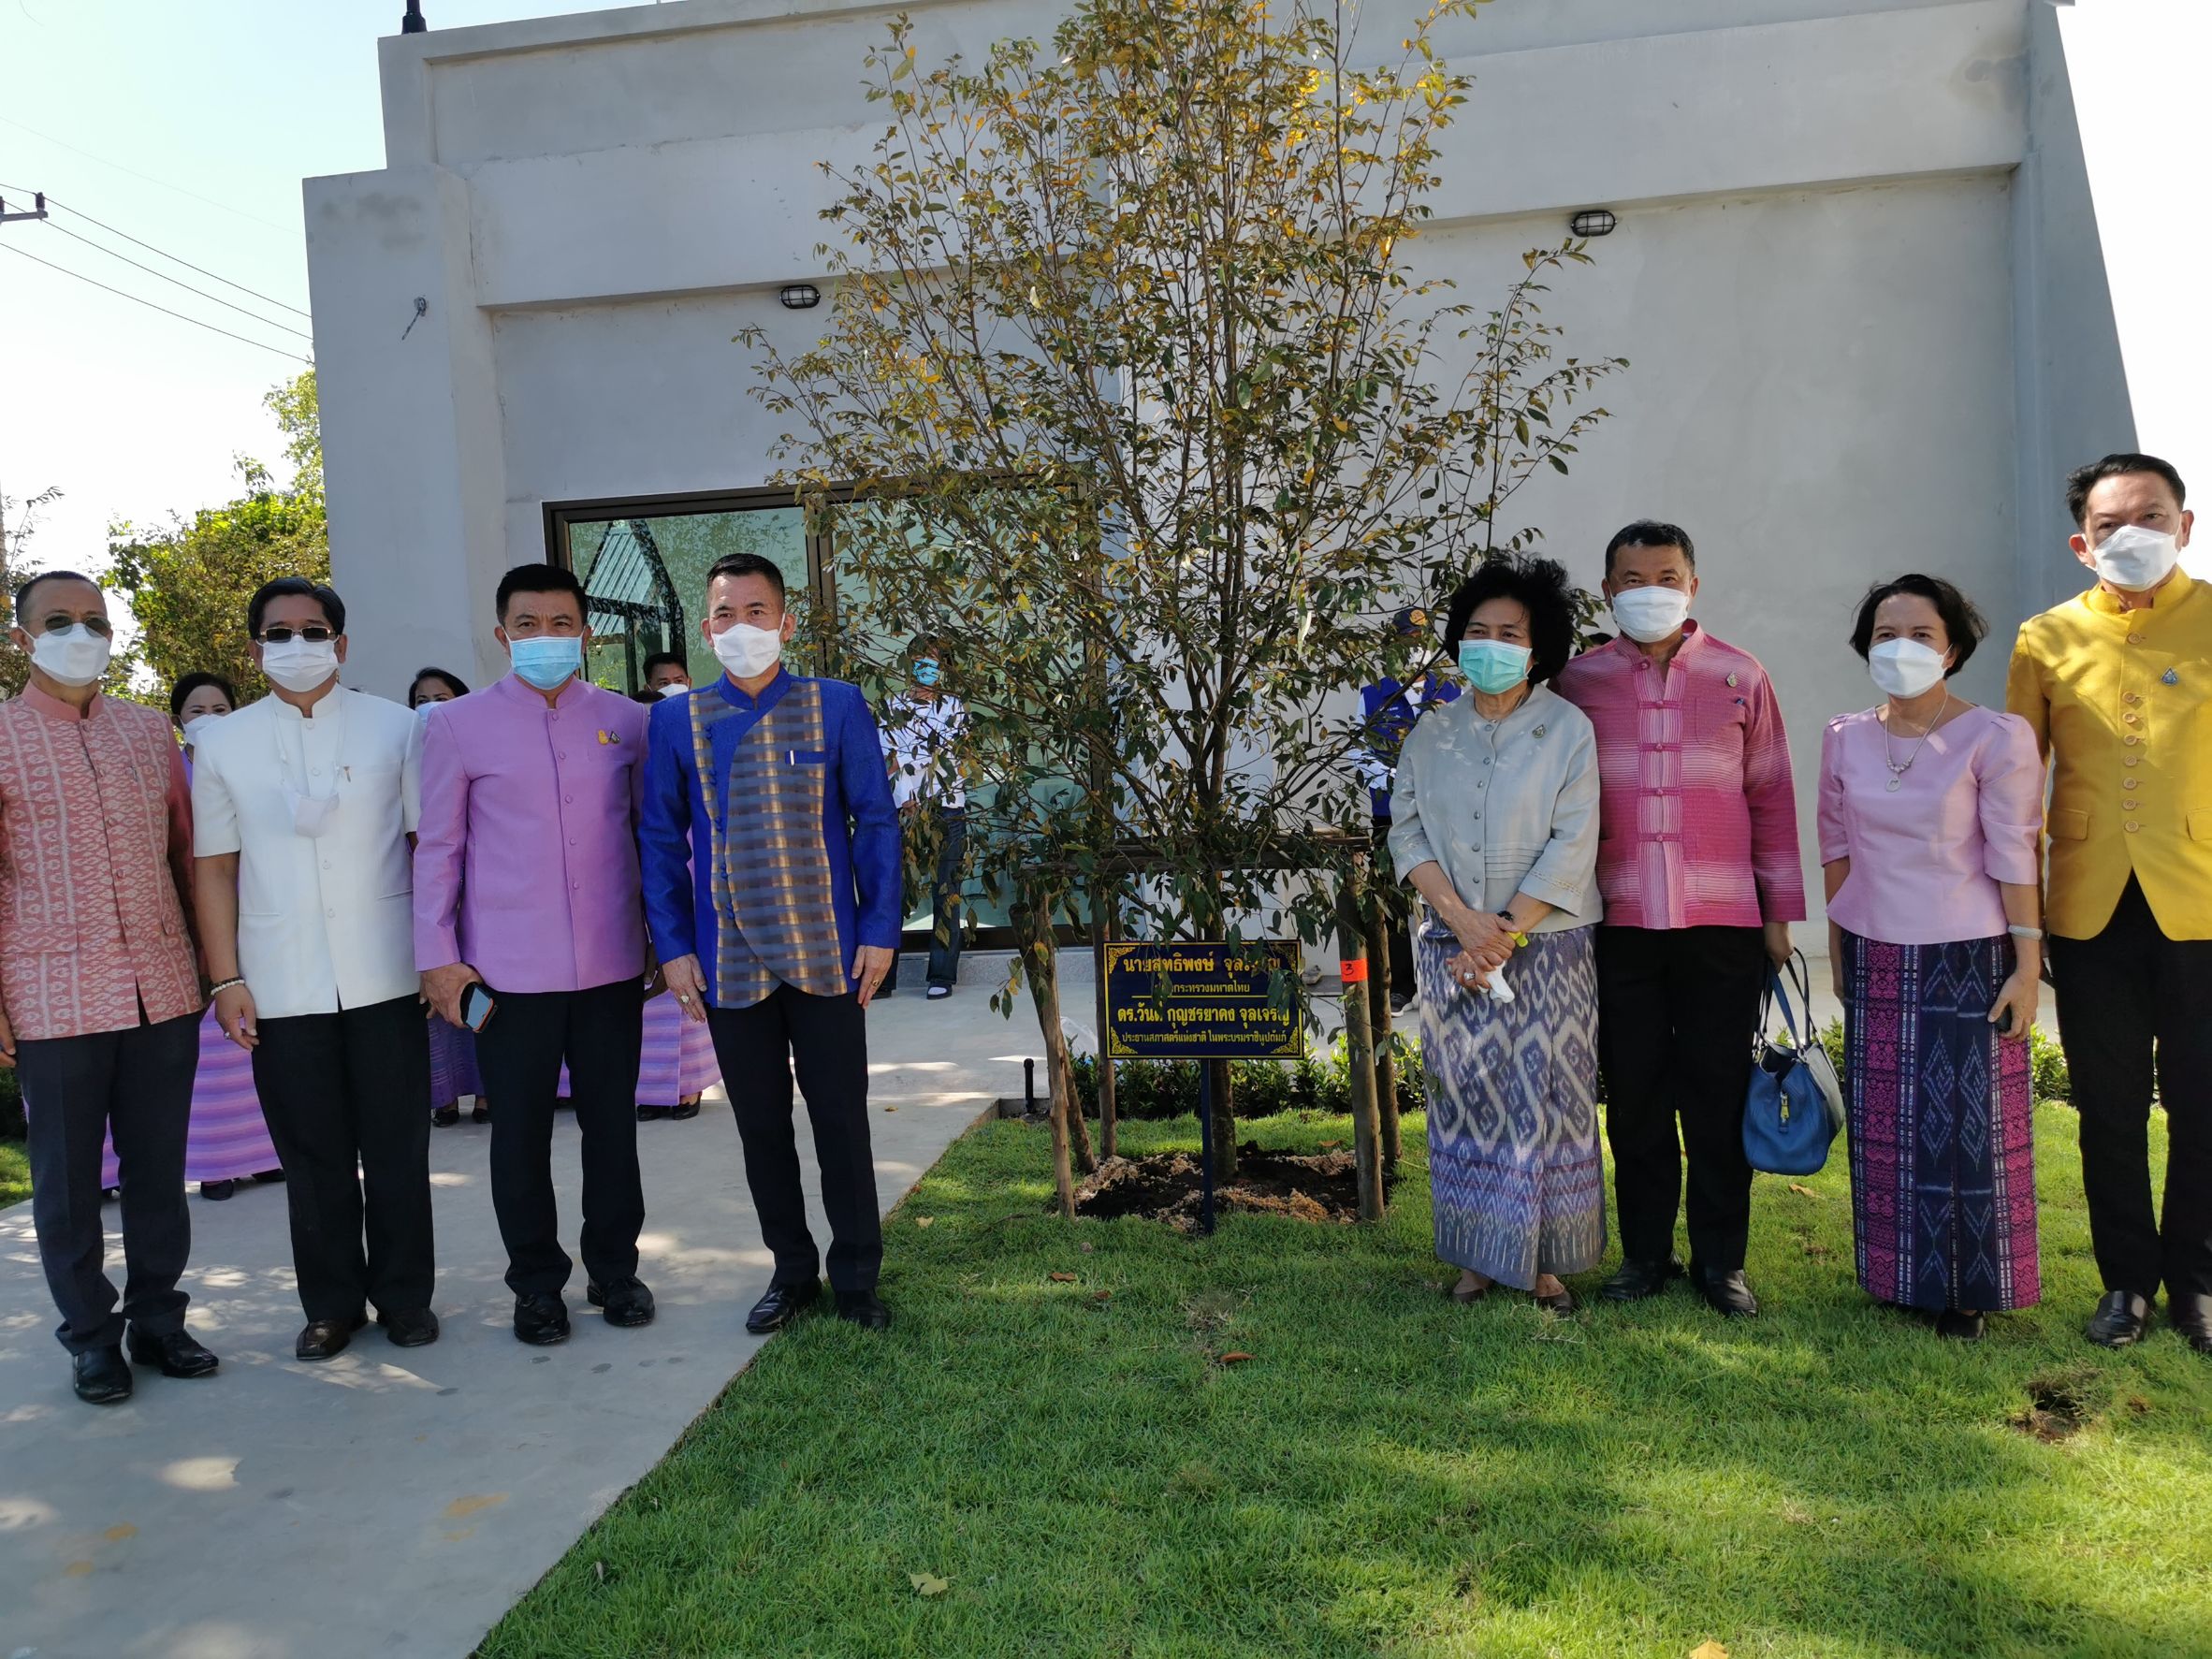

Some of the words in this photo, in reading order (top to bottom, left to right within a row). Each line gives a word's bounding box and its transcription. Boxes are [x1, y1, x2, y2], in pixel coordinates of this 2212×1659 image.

[1155, 980, 1250, 992] กระทรวงมหาดไทย
[1239, 1007, 1290, 1029] จุลเจรญ
